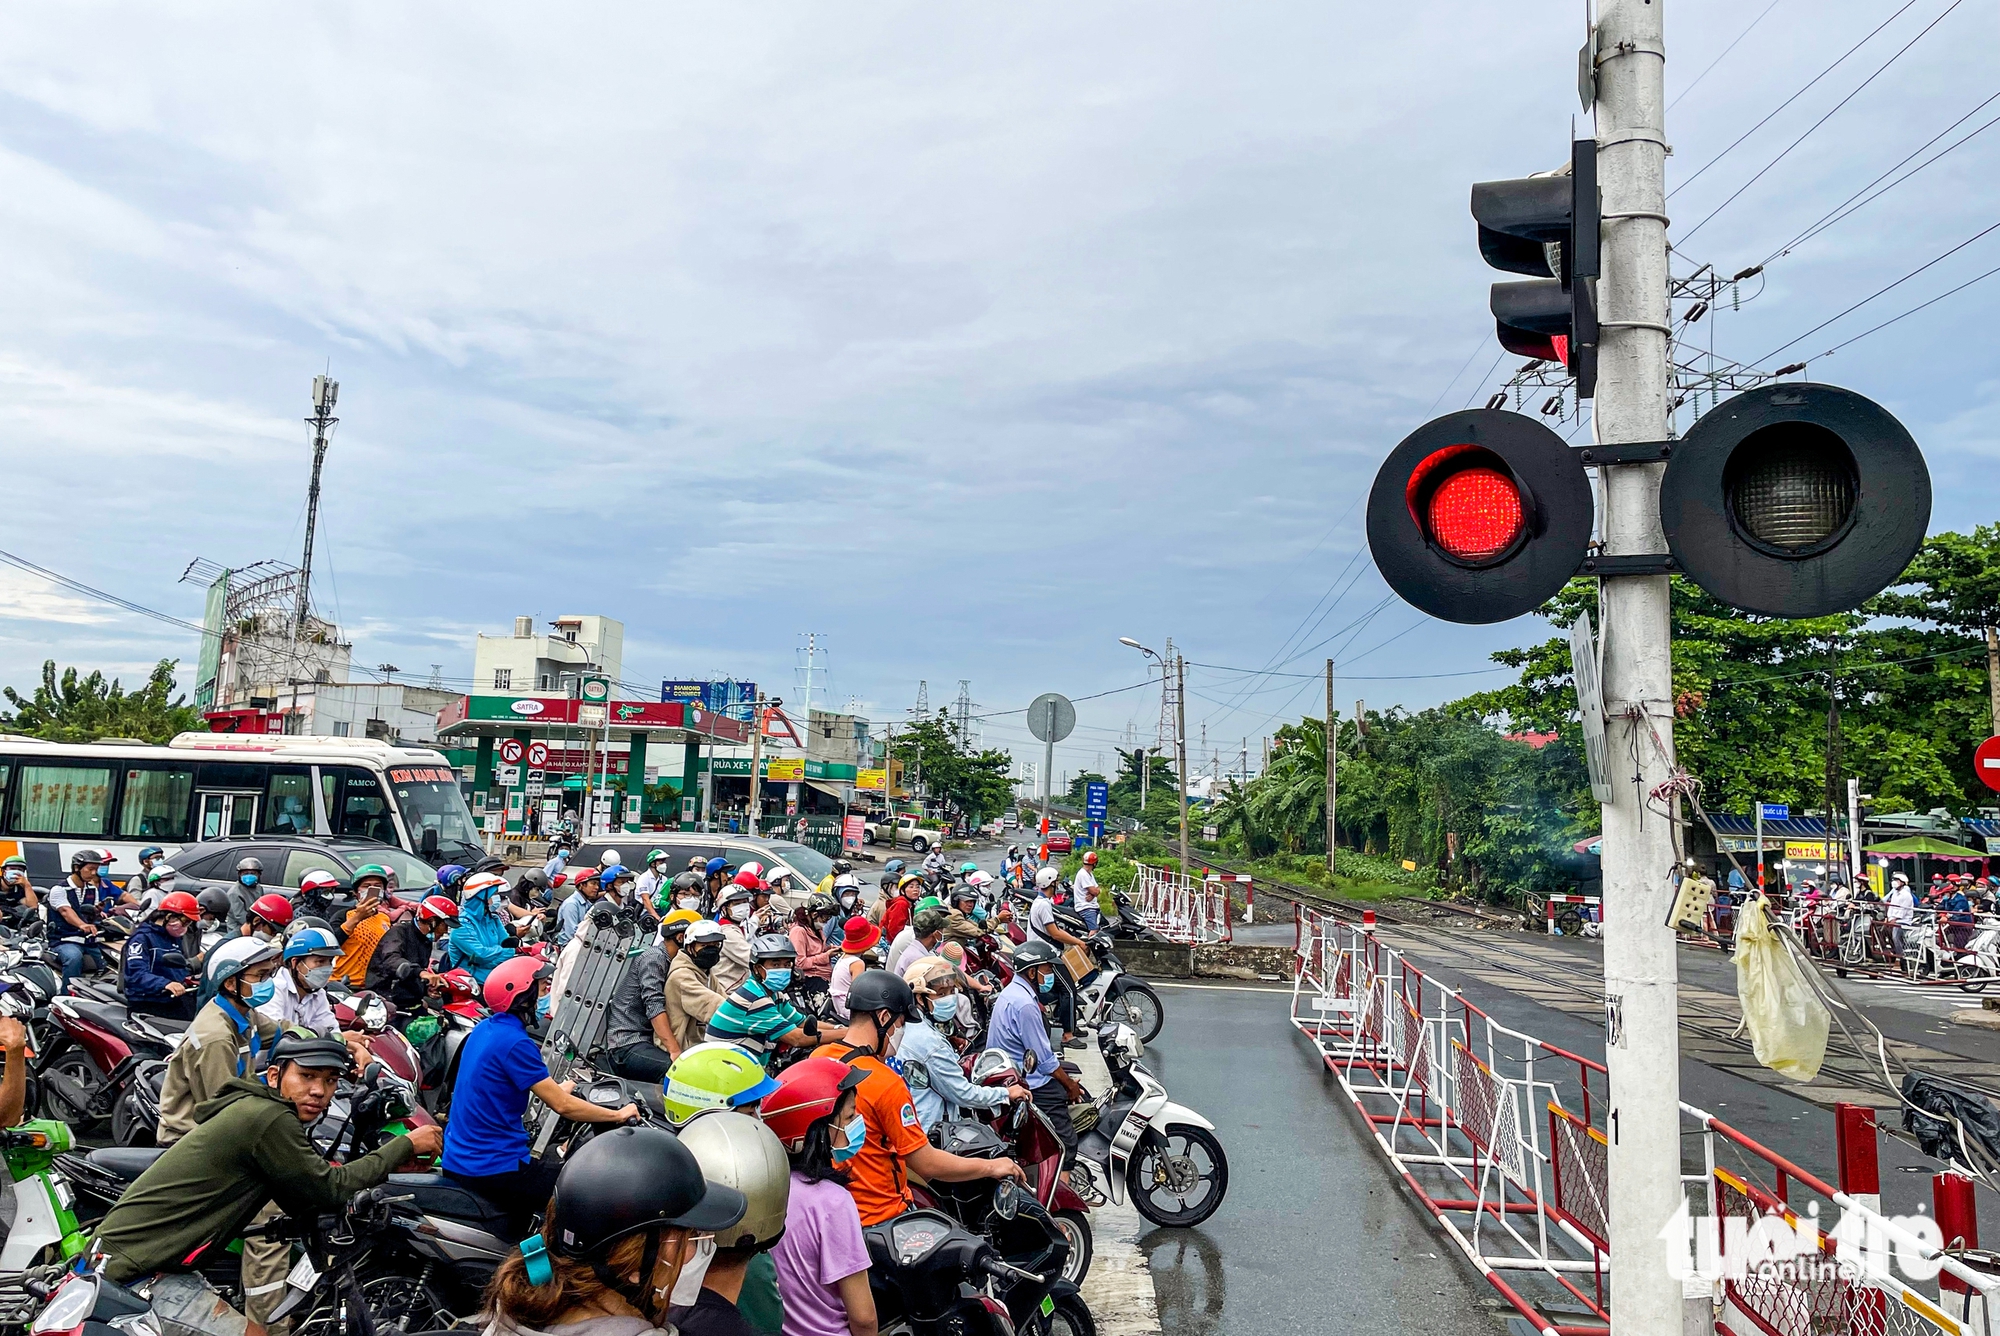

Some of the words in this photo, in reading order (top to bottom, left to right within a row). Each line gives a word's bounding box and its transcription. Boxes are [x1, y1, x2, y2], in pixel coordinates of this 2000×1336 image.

[588, 684, 603, 693] SATRA
[516, 703, 539, 711] SATRA
[347, 779, 376, 787] SAMCO
[1120, 1128, 1138, 1140] YAMAHA
